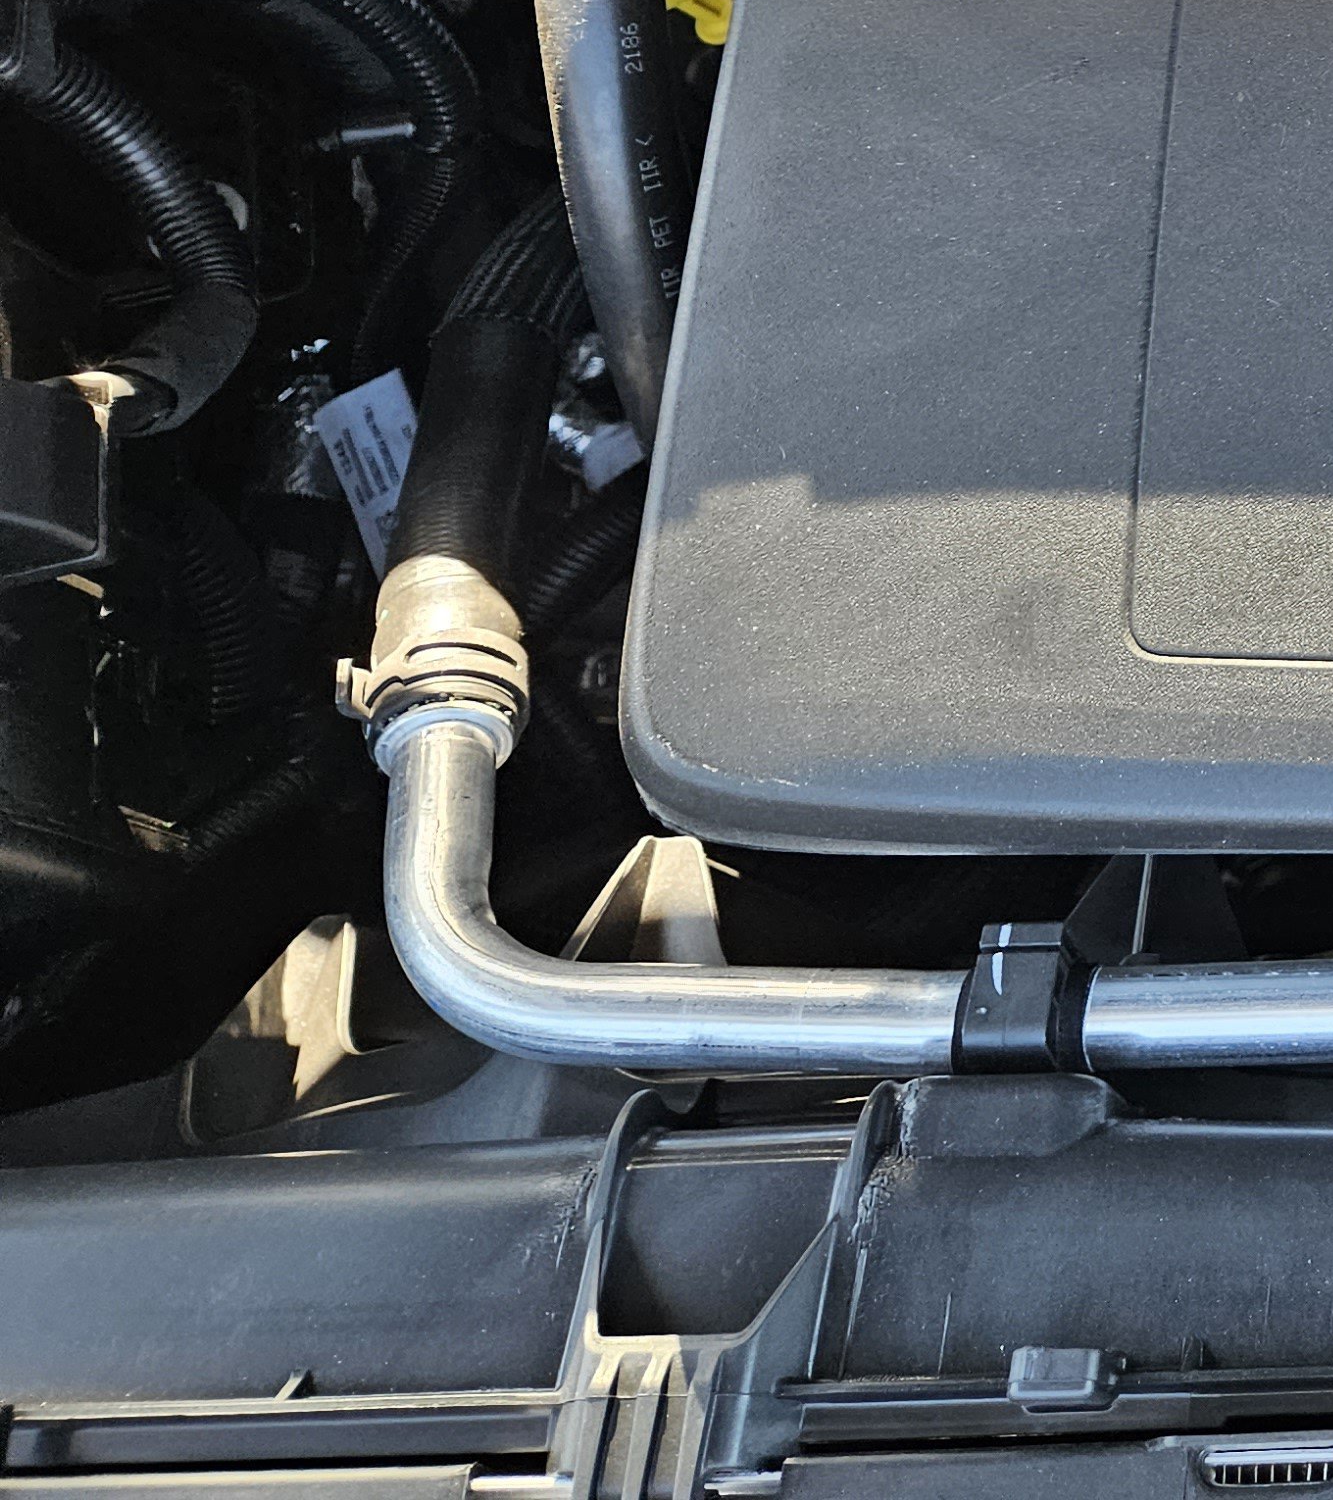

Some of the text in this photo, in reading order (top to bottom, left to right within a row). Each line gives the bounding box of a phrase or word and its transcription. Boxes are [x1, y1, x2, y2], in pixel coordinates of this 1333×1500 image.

[620, 22, 643, 75] 2186
[640, 156, 664, 193] IIR
[650, 216, 675, 249] PET
